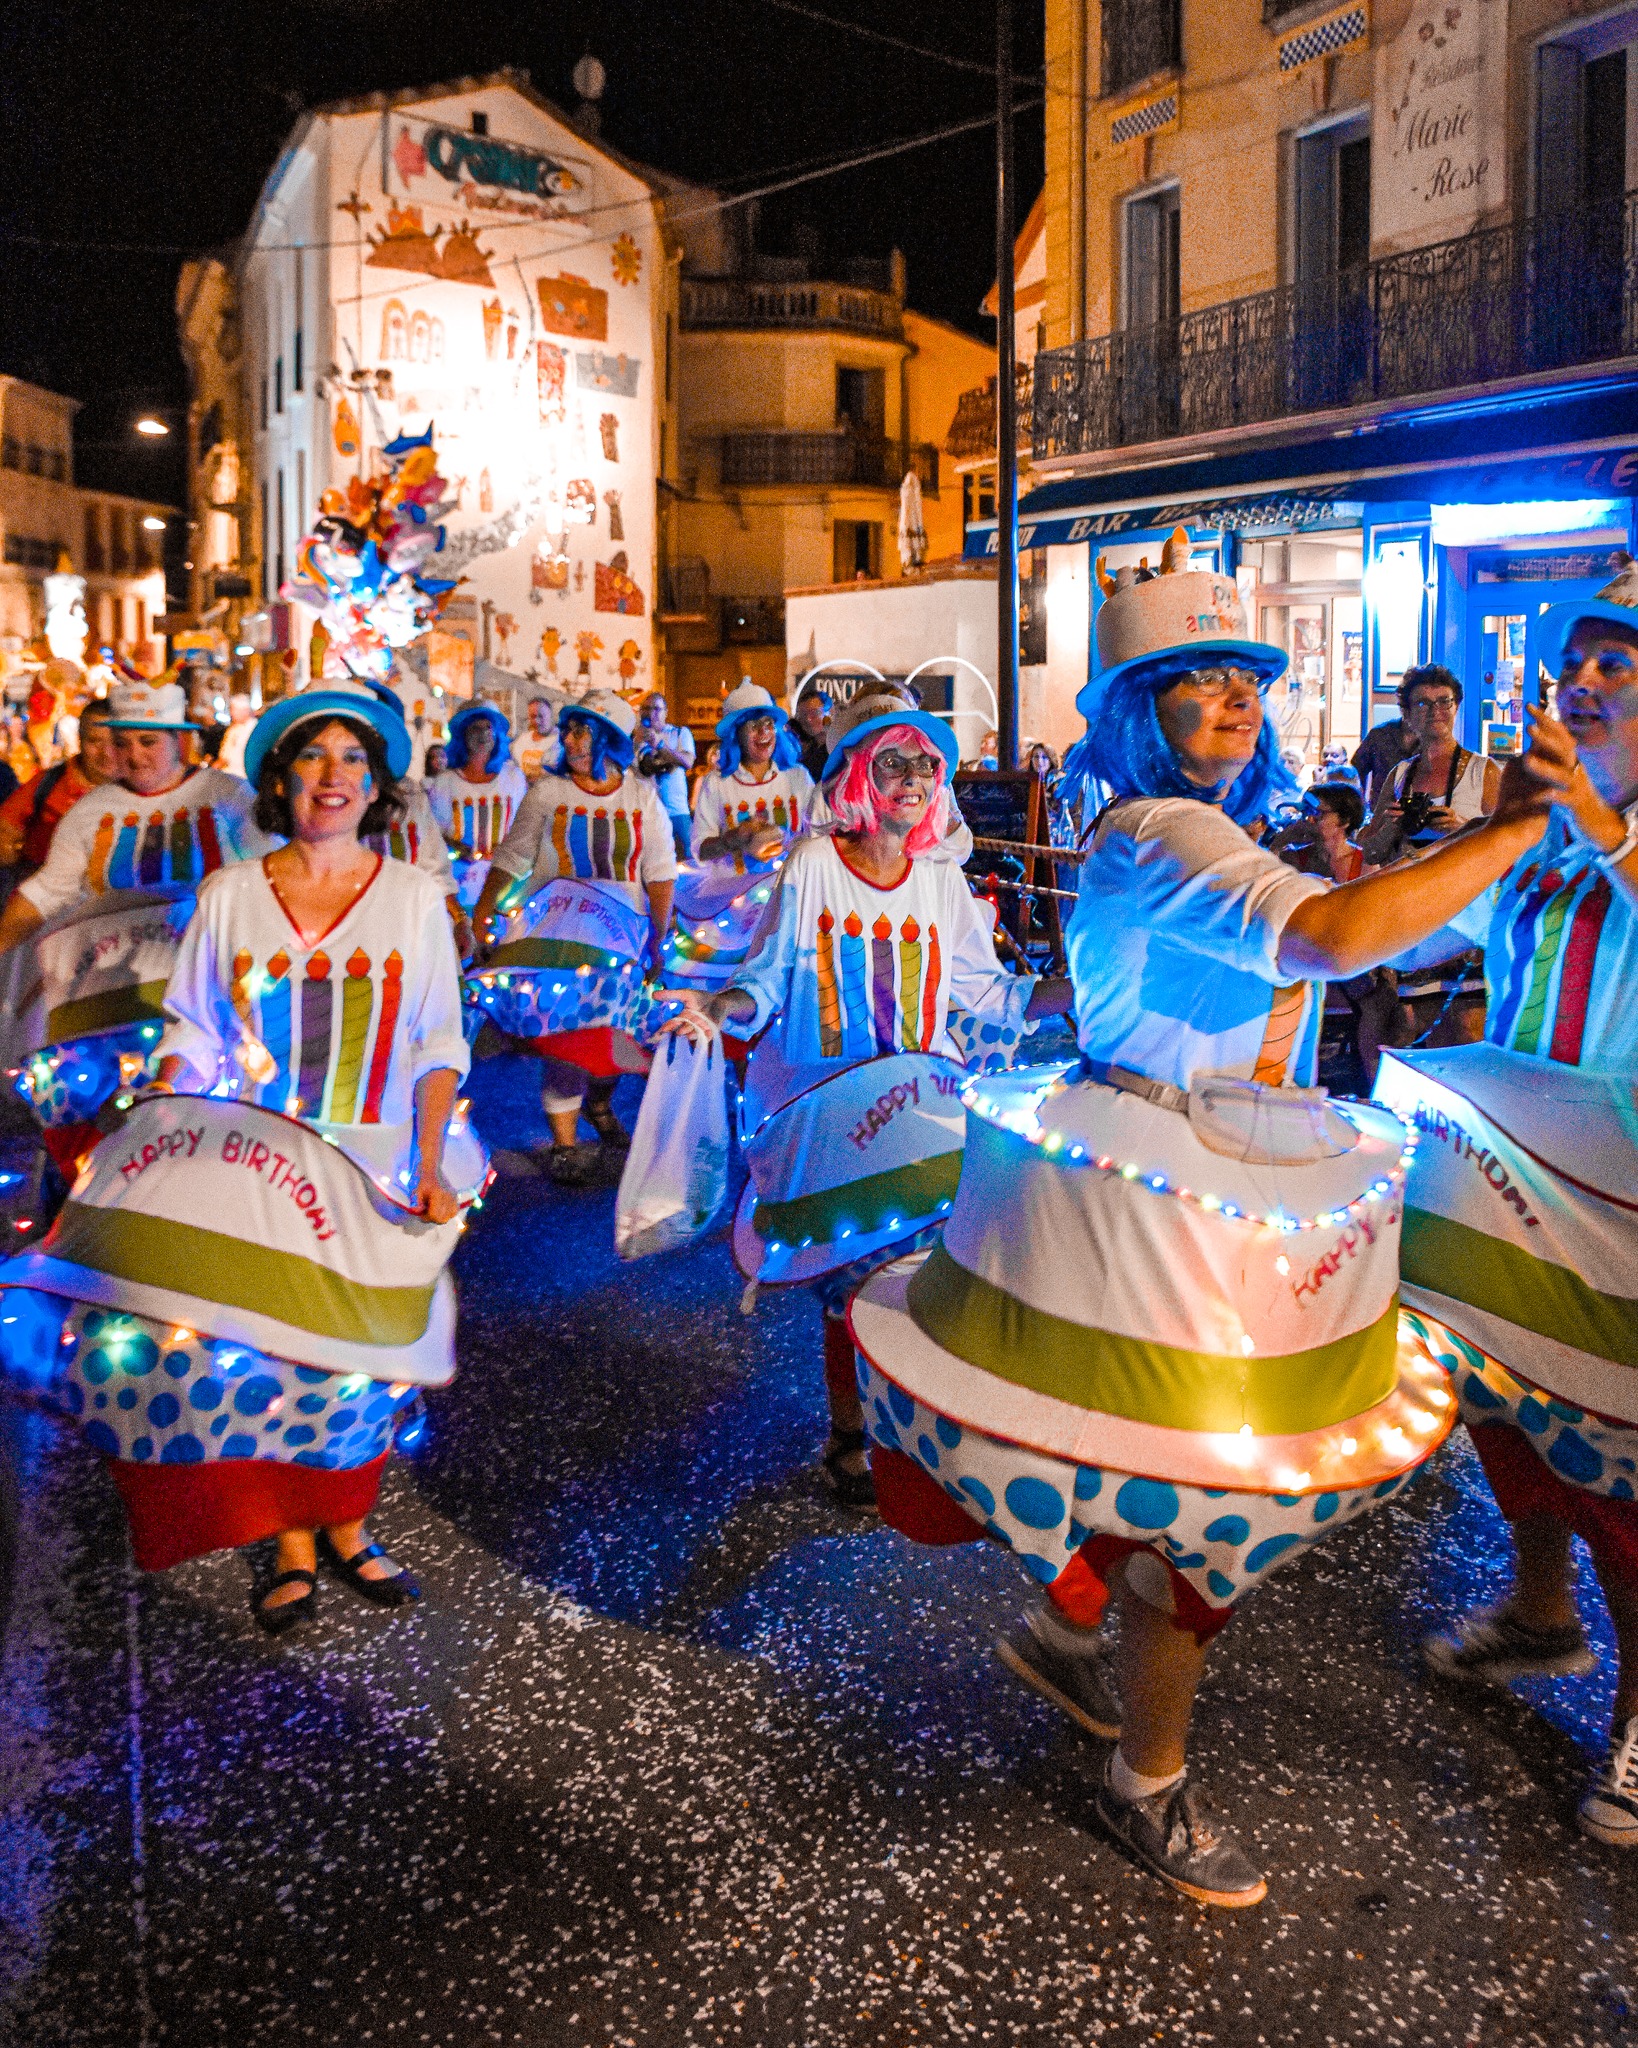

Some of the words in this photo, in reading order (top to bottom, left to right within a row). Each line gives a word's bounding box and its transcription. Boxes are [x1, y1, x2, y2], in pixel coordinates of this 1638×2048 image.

[1393, 104, 1473, 156] Marie
[1424, 156, 1490, 202] Rose
[1066, 512, 1130, 541] BAR
[846, 1076, 920, 1151] HAPPY
[120, 1126, 205, 1183] HAPPY
